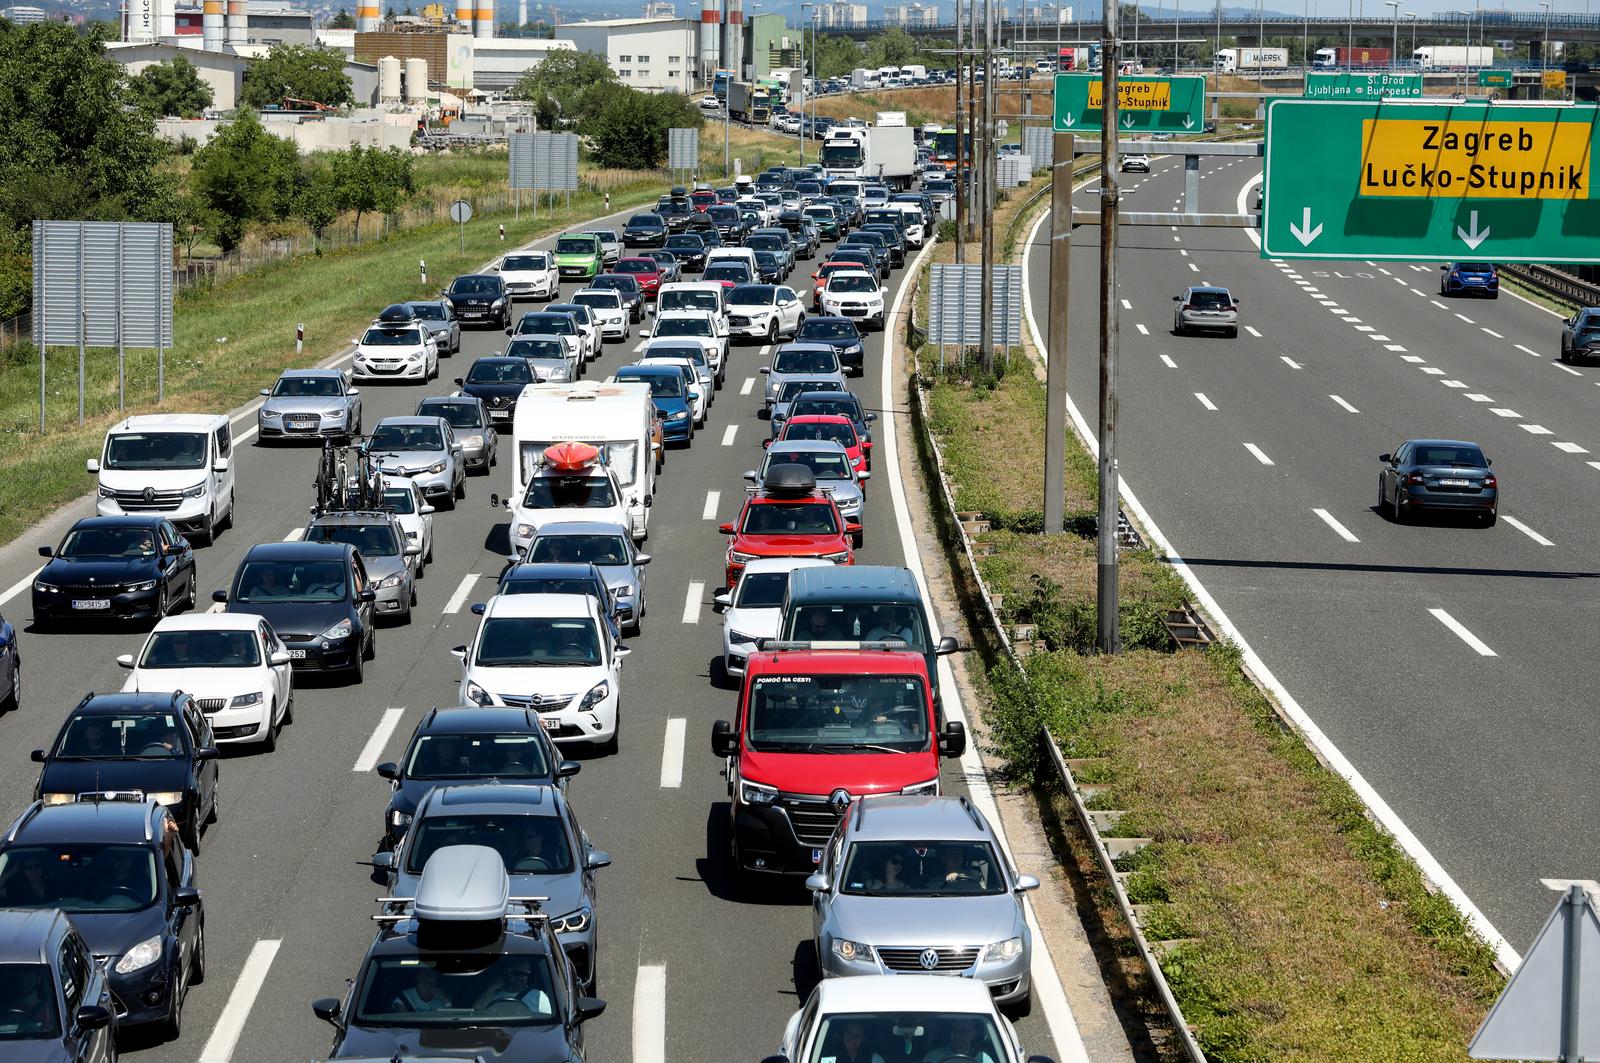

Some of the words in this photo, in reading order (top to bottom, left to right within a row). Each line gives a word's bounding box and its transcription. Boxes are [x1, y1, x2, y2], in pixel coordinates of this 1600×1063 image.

[1253, 53, 1282, 61] MAERSK
[1382, 75, 1404, 85] Brod
[1117, 83, 1150, 95] agreb
[1308, 85, 1351, 96] Ljubljana
[1090, 97, 1168, 109] Lu-Stupnik
[1422, 126, 1533, 157] Zagreb
[1366, 163, 1583, 195] Lučko-Stupnik
